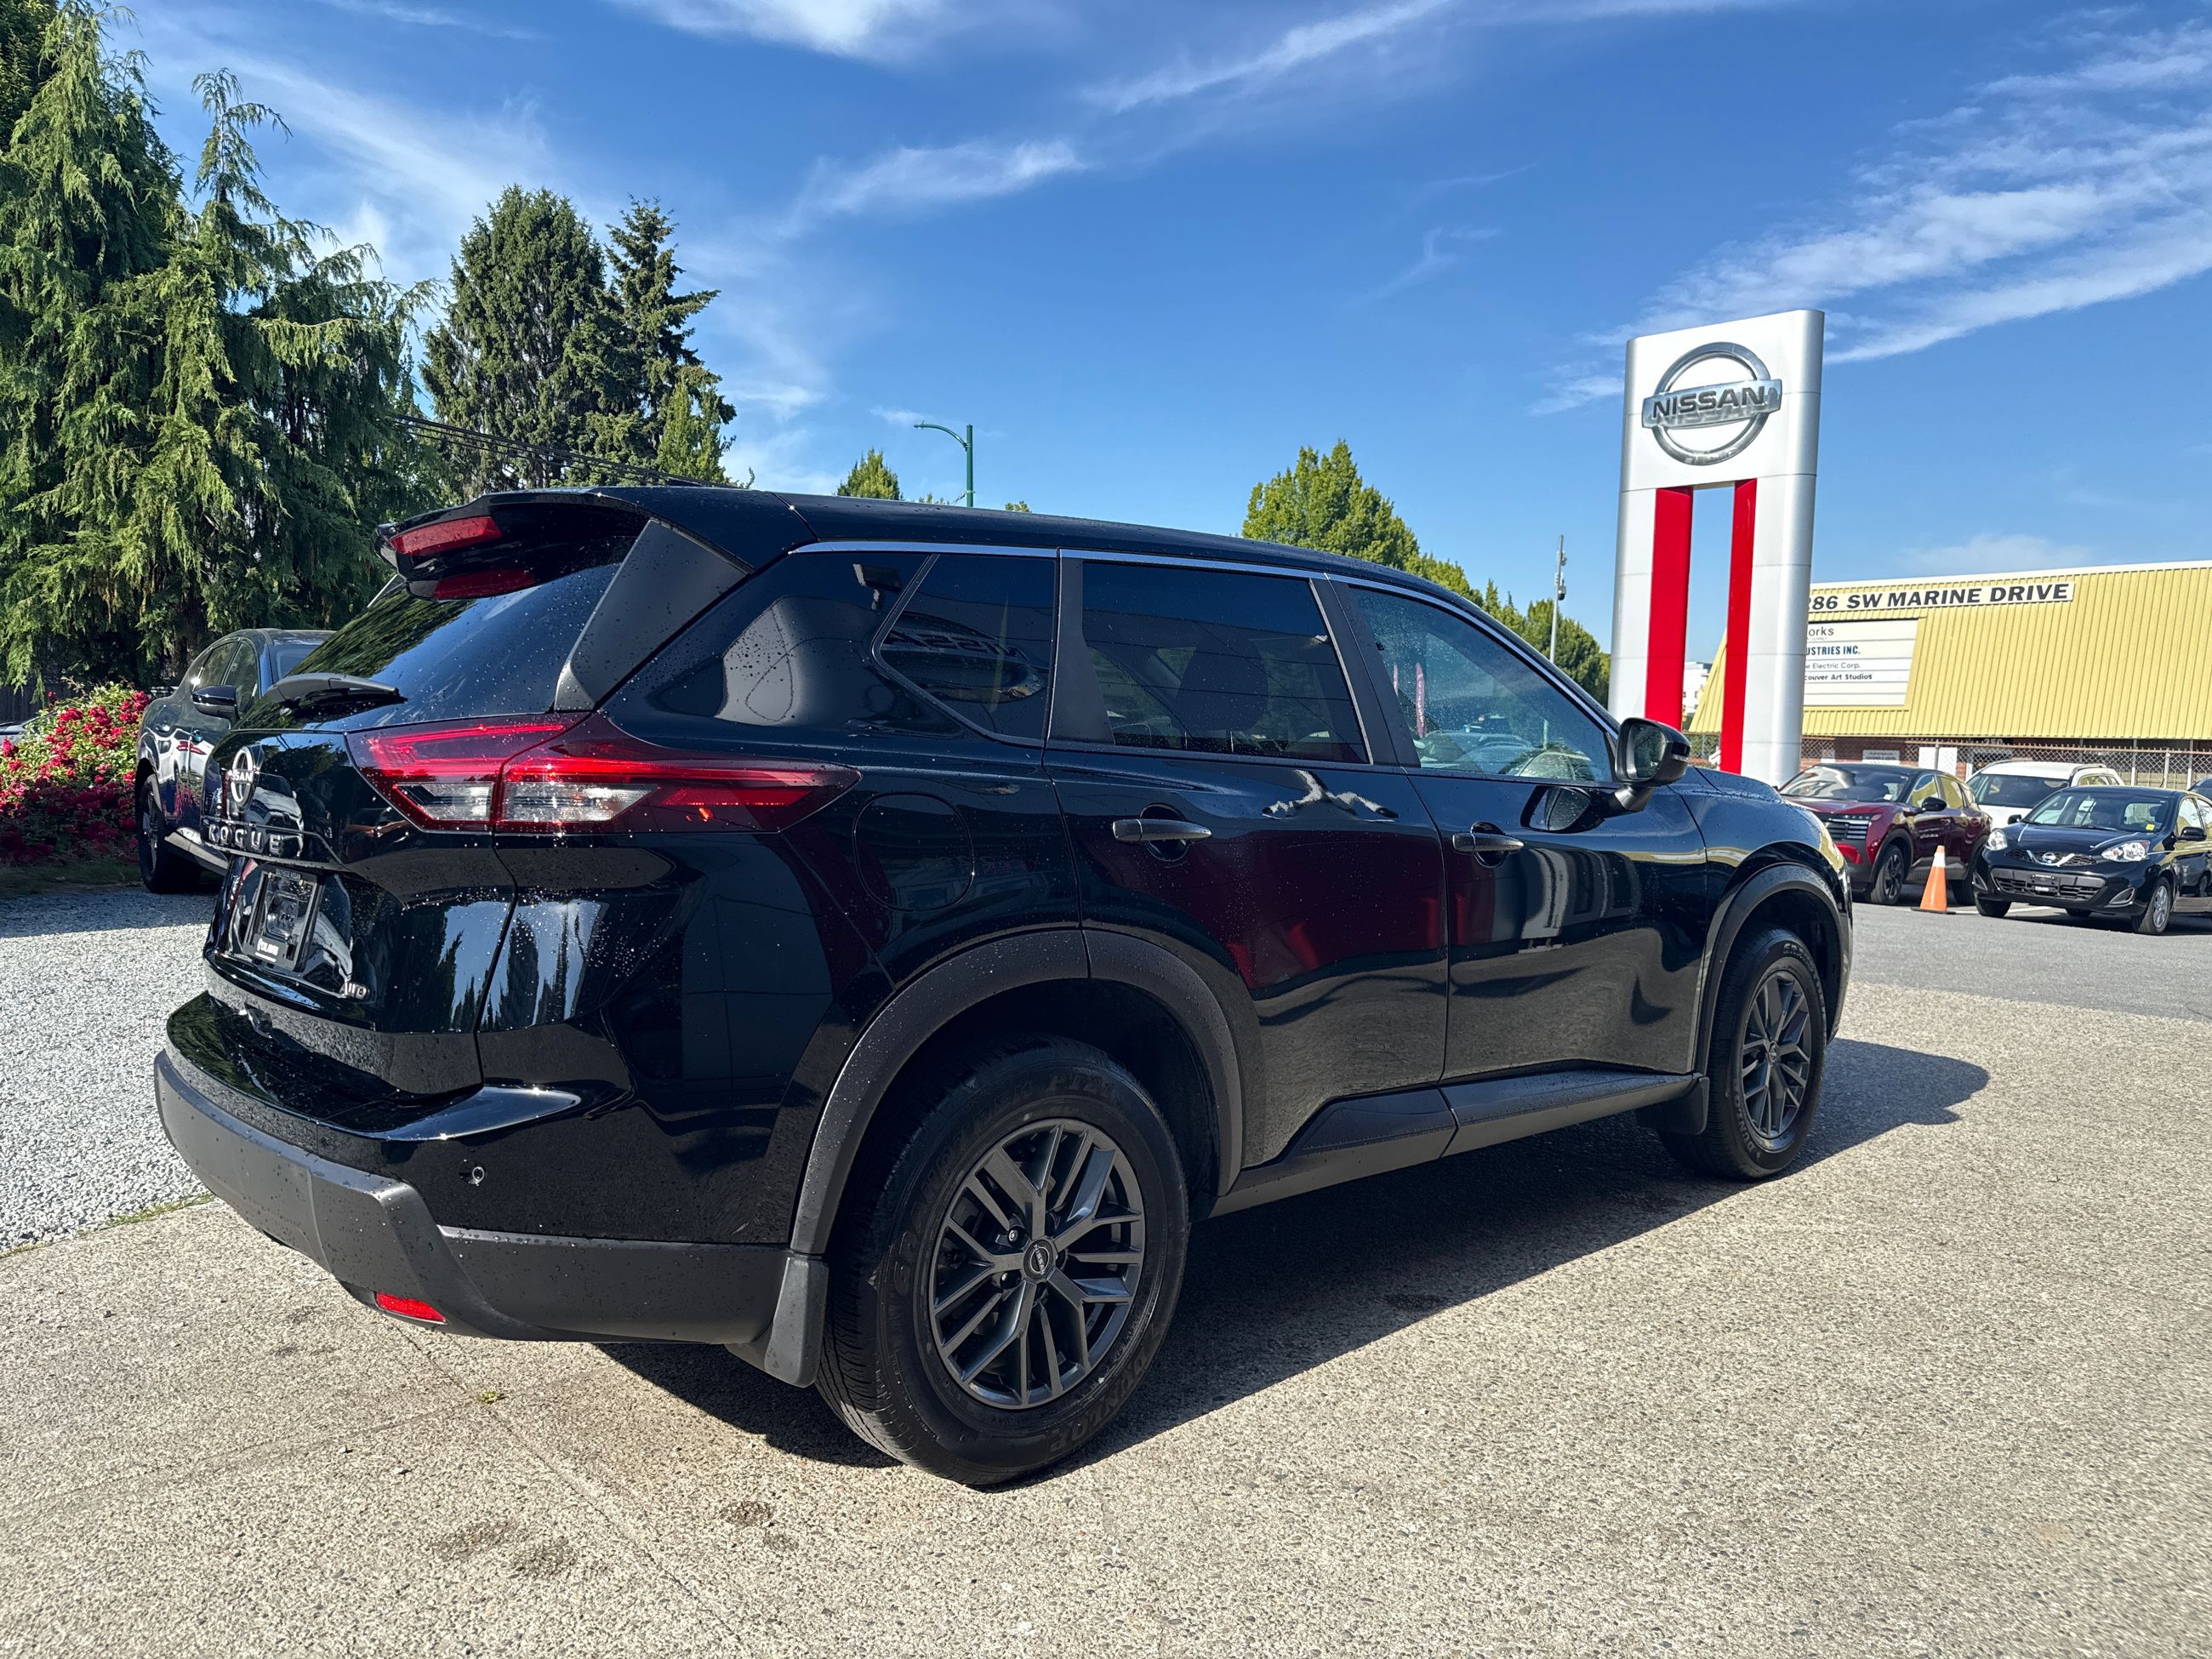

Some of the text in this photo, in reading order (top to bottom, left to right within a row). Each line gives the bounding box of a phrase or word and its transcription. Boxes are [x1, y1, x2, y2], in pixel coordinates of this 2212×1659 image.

[1652, 385, 1765, 419] NISSAN
[1809, 583, 2069, 610] 86 SW MARINE DRIVE
[1843, 646, 1861, 655] INC.
[208, 824, 282, 853] ROGUE
